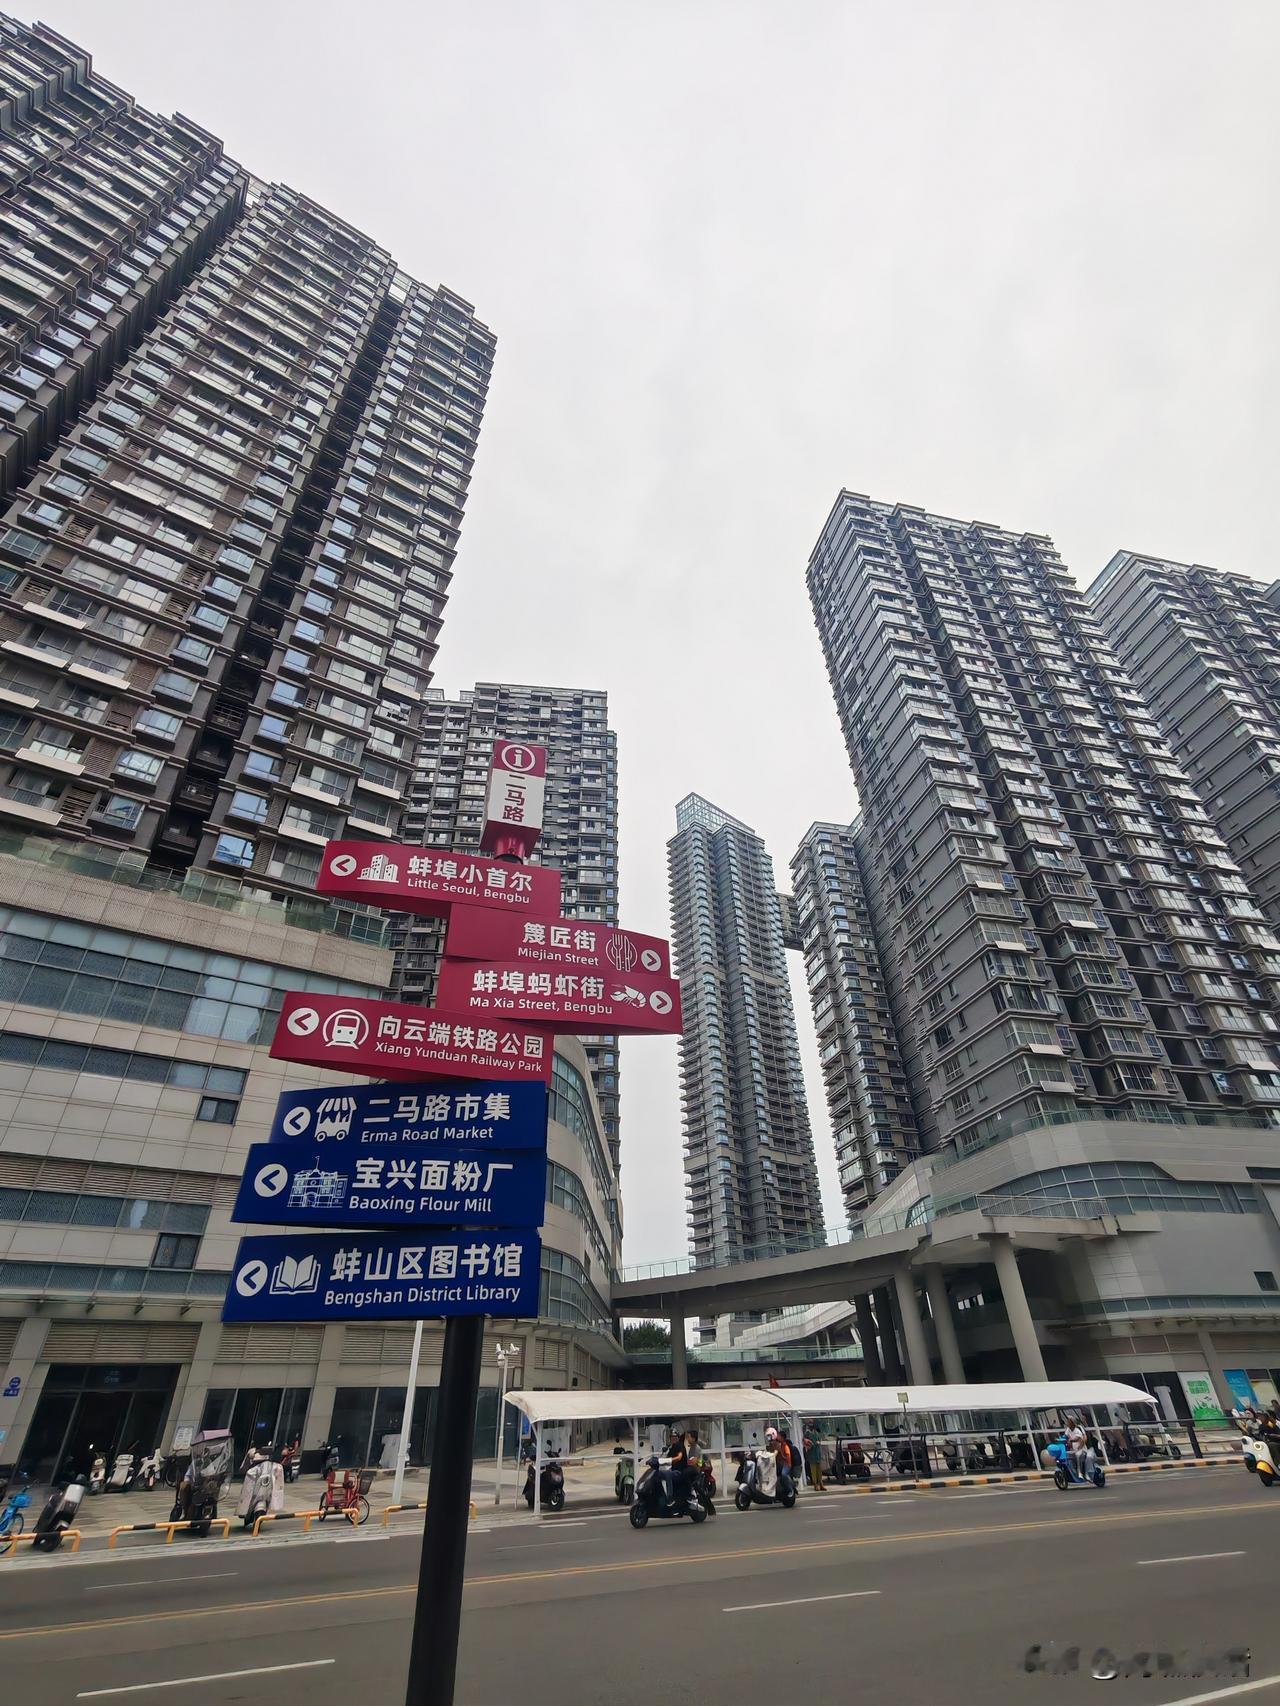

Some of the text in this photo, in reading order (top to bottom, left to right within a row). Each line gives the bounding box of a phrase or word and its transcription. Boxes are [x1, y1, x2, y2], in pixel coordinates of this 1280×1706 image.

[503, 774, 526, 823] 二马路
[407, 855, 533, 892] 蚌埠小首尔
[407, 878, 530, 904] Little Seoul, Bengbu
[518, 948, 599, 966] Miejian Street
[472, 969, 605, 1000] 蚌埠蚂虾街
[470, 997, 613, 1015] Ma Xia Street, Bengbu
[377, 1015, 544, 1059] 向云端铁路公园
[375, 1042, 542, 1072] Xiang Yunduan Railway Park
[363, 1092, 511, 1124] 二马路市集
[361, 1126, 494, 1143] Erma Road Market
[352, 1157, 514, 1193] 宝兴面粉厂
[349, 1196, 492, 1214] Baoxing Flour Mill
[330, 1243, 523, 1282] 蚌山区图书馆
[324, 1284, 521, 1308] Bengshan District Library
